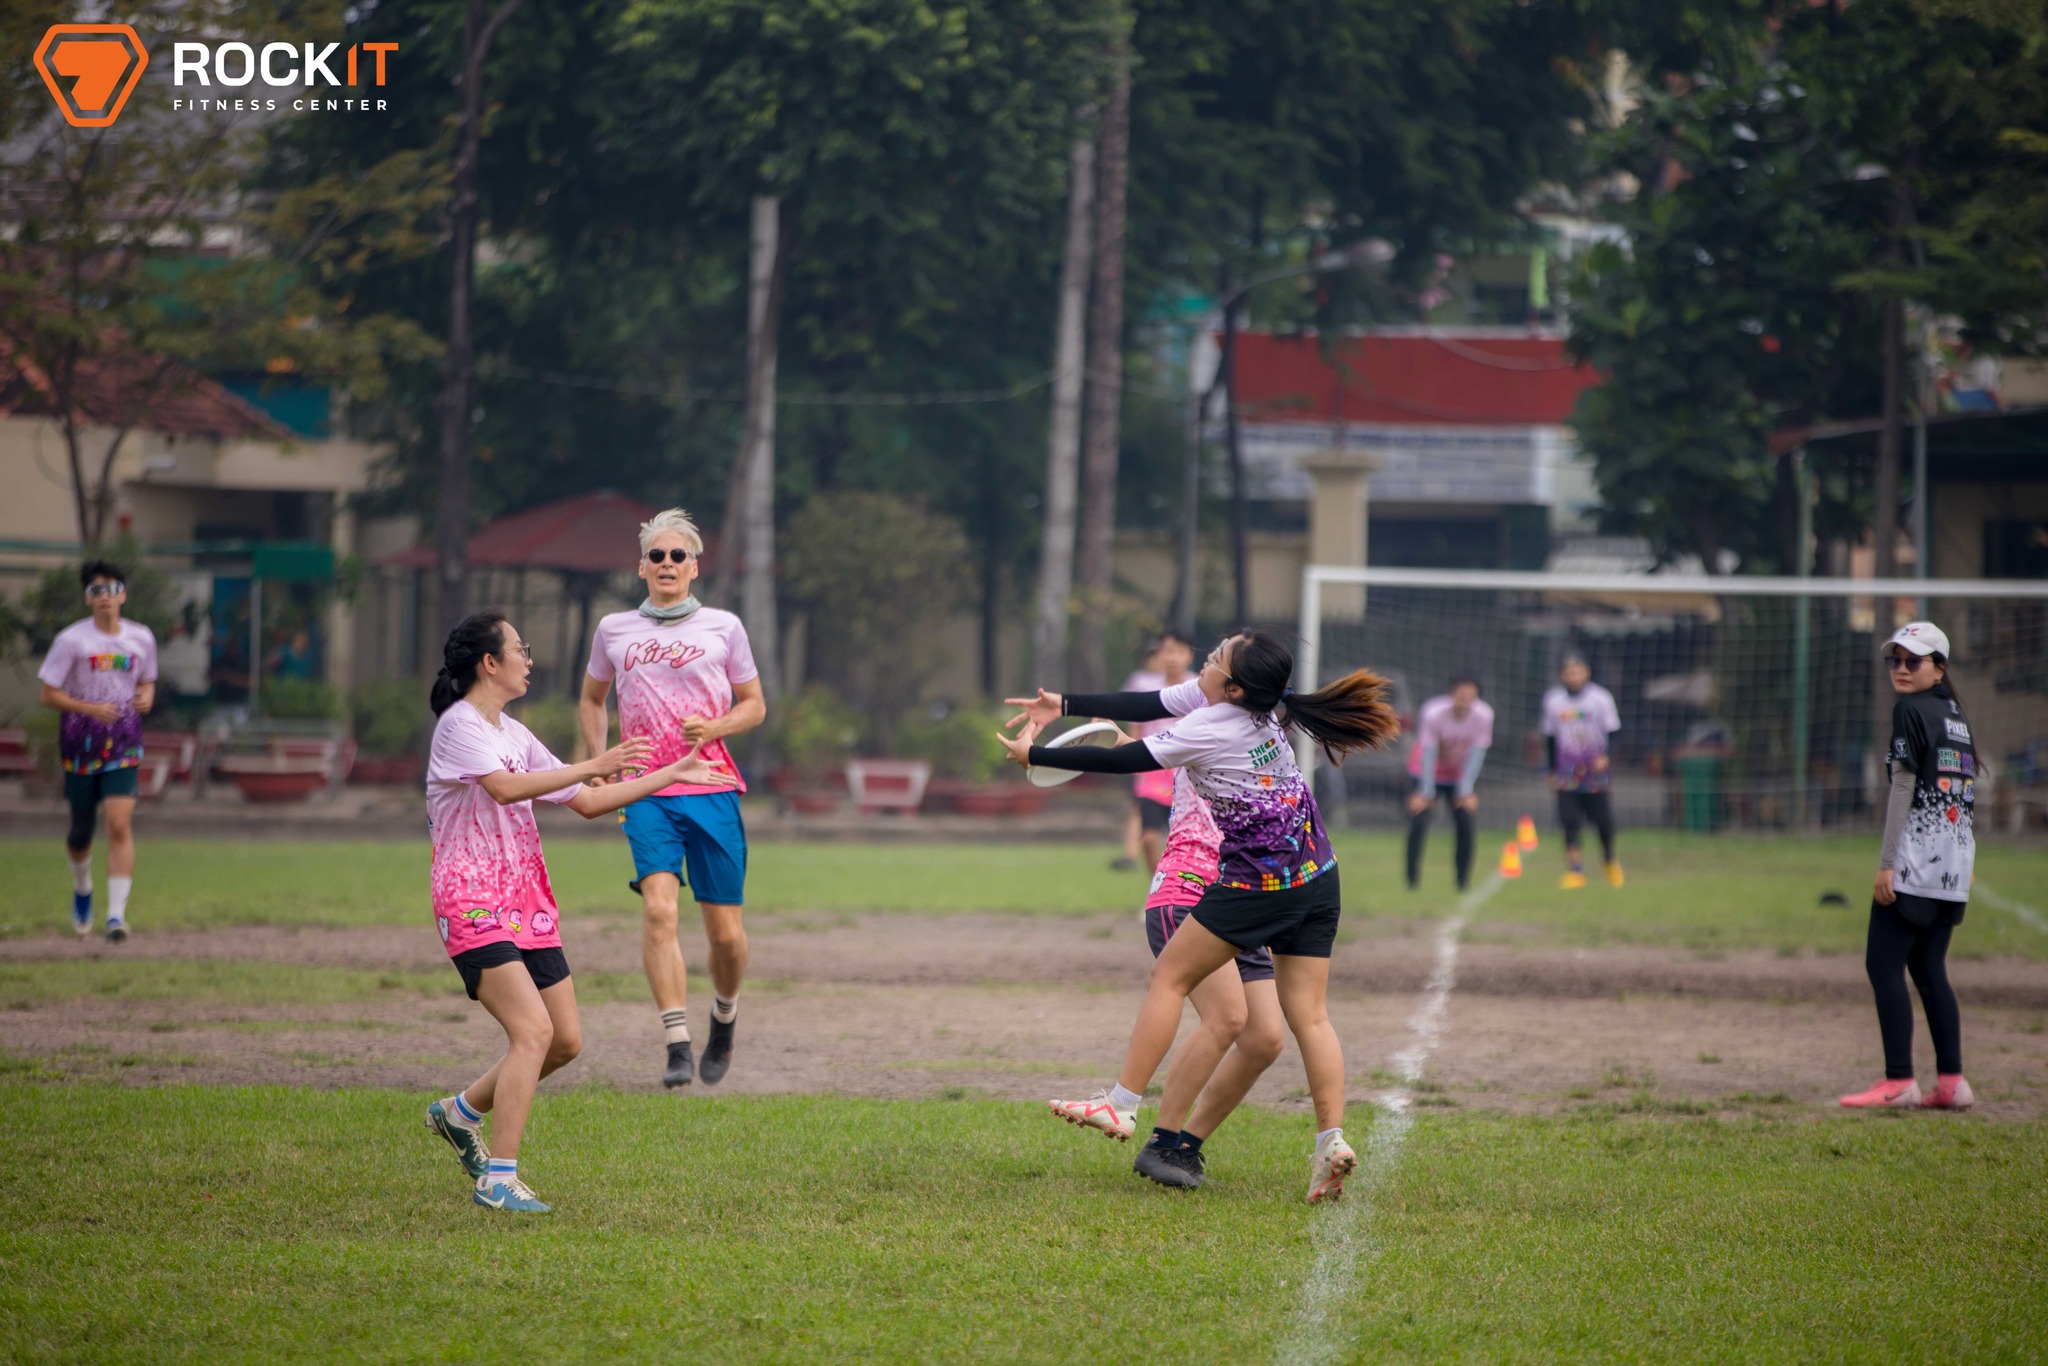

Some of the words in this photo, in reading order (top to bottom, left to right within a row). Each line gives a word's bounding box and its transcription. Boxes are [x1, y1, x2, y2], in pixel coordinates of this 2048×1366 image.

[625, 638, 705, 671] Kirby
[1248, 744, 1266, 759] THE
[1252, 746, 1281, 769] STREET
